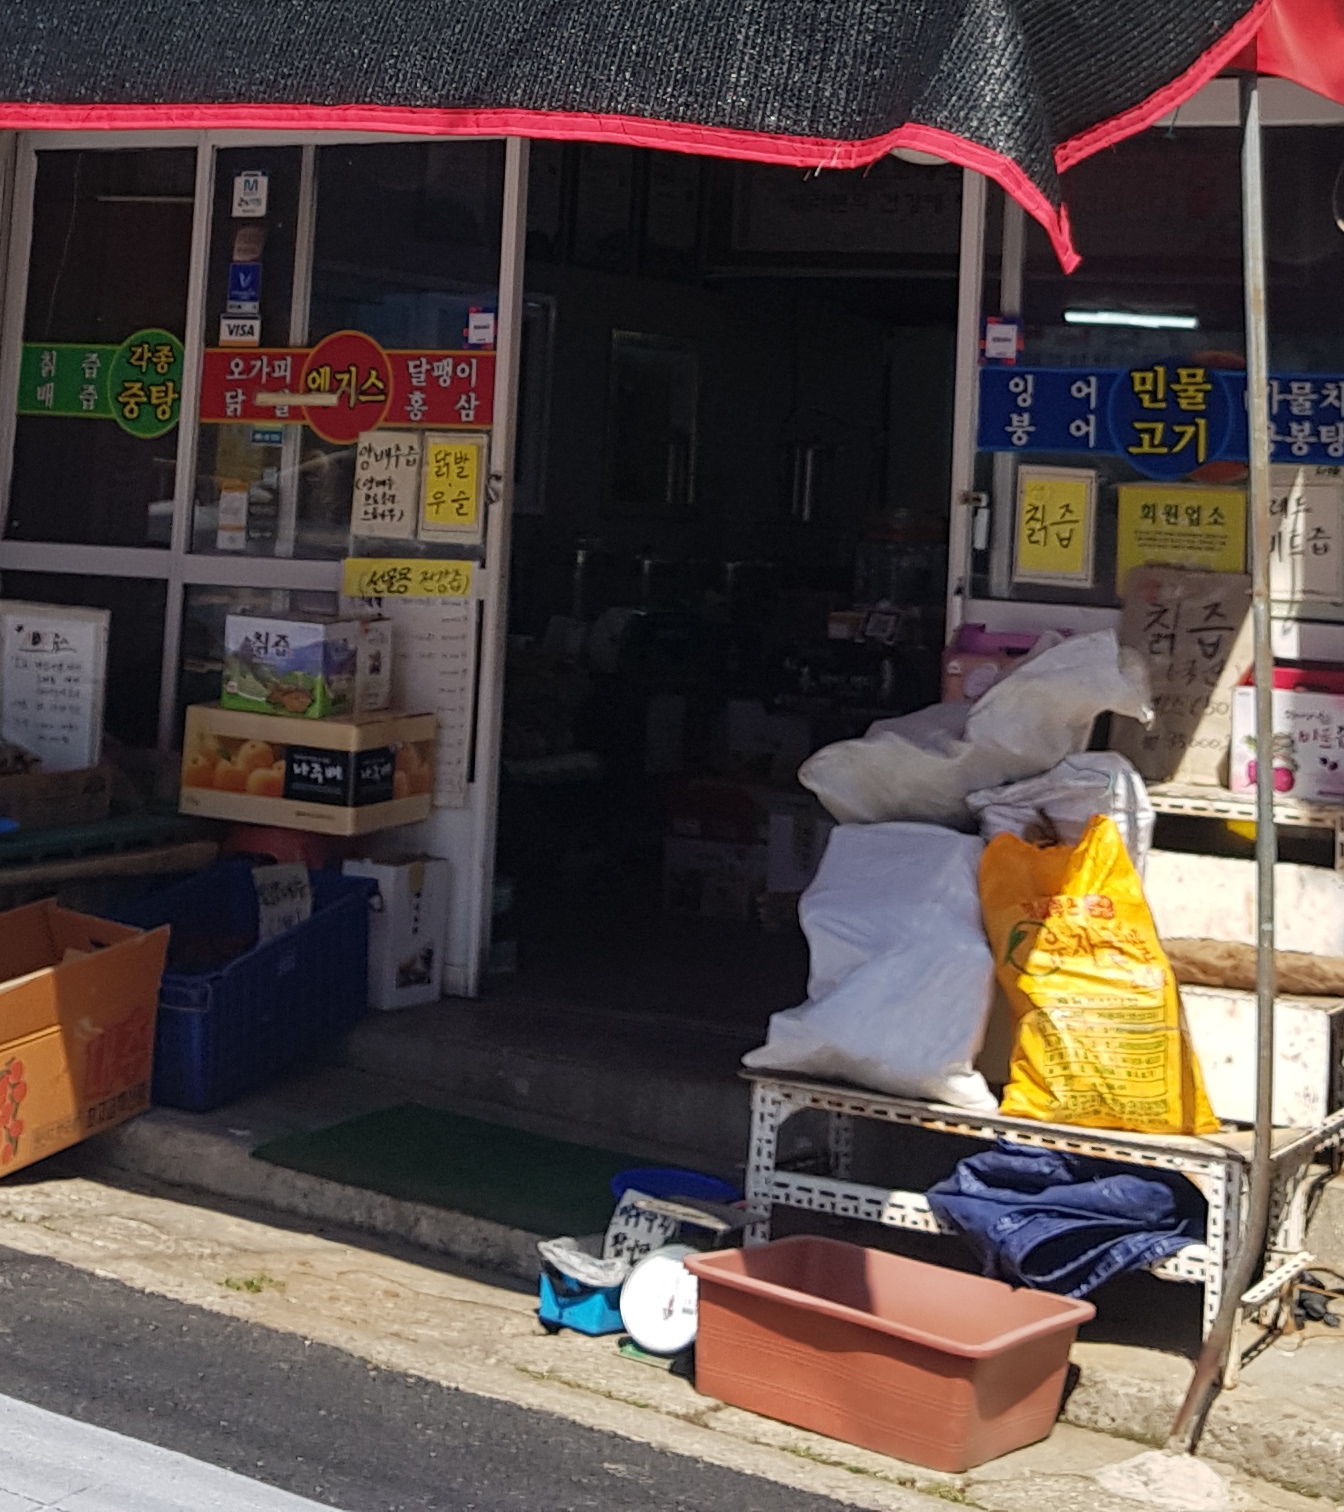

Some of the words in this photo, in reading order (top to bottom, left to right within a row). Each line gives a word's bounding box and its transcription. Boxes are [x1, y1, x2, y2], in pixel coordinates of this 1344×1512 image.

[226, 323, 256, 338] VISA
[129, 343, 175, 375] 각종
[407, 356, 478, 389] 달팽이
[117, 380, 180, 422] 중탕
[1130, 365, 1213, 412] 민물
[1127, 417, 1209, 463] 고기
[1139, 502, 1227, 529] 회원업소
